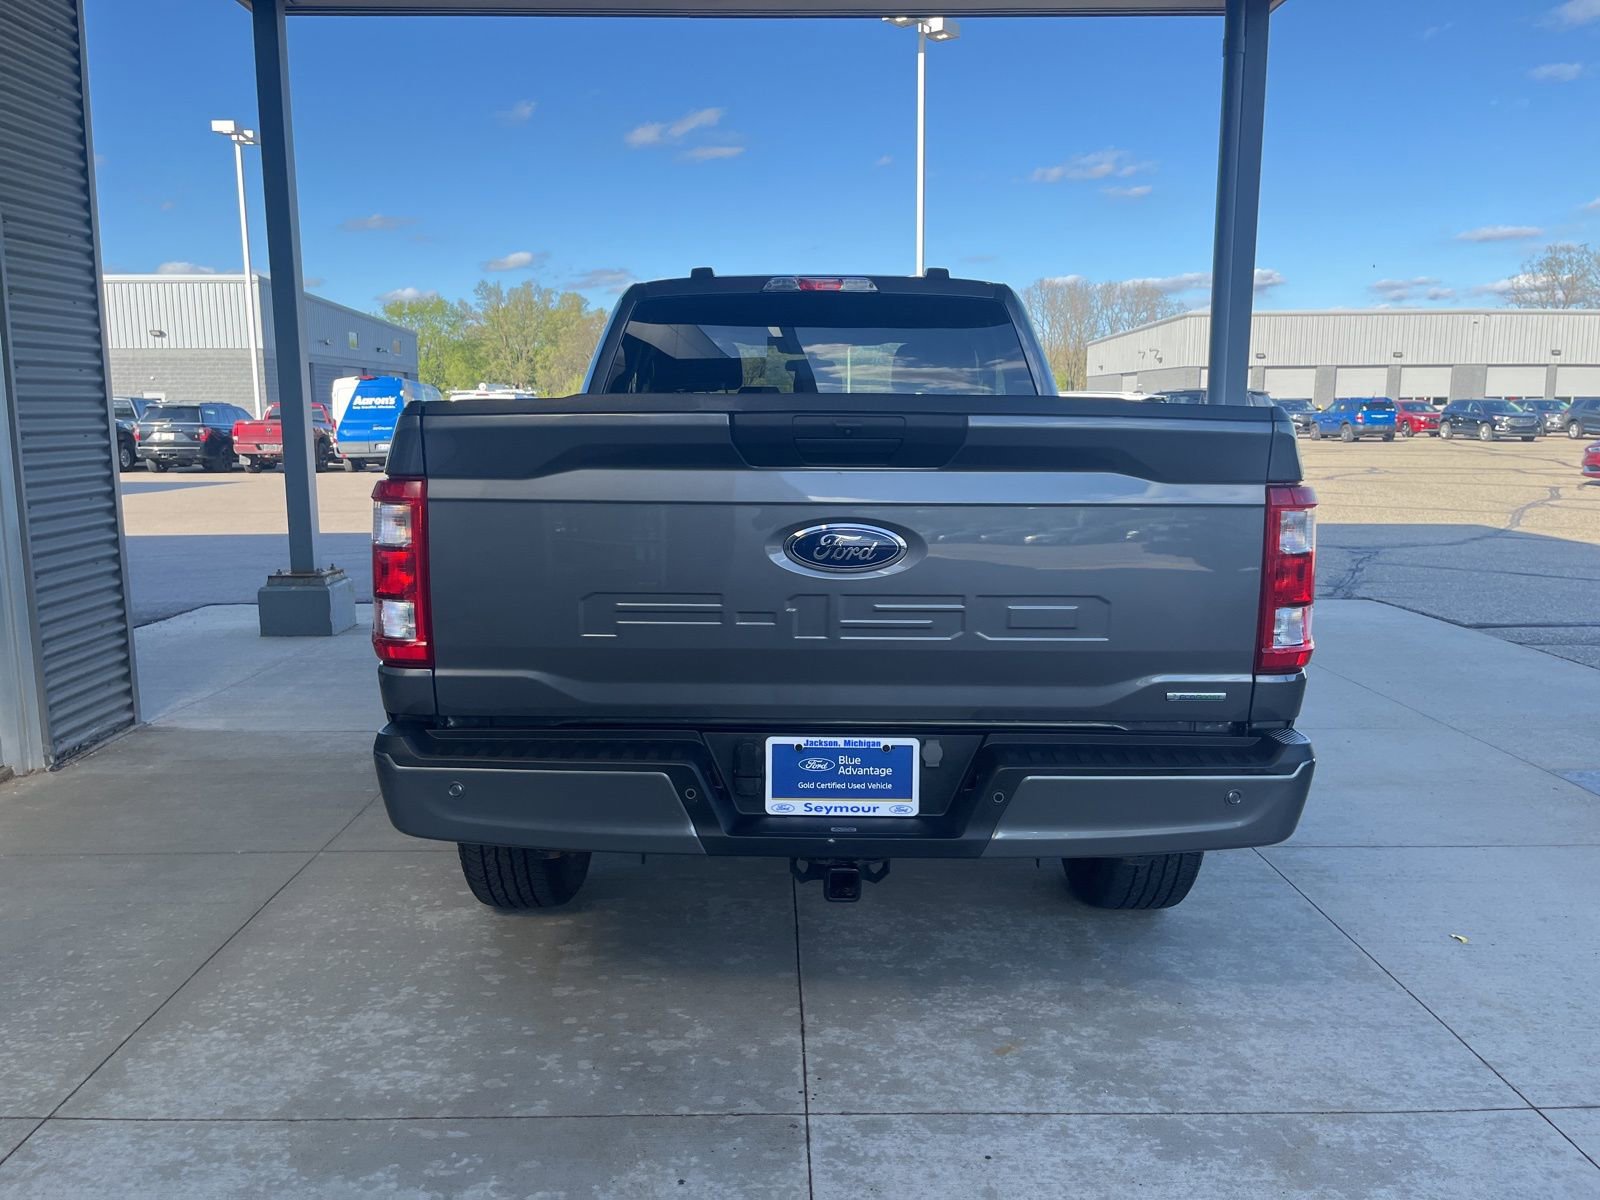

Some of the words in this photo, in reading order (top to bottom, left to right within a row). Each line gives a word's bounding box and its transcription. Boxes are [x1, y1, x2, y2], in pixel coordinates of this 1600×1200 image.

[813, 534, 878, 560] Ford
[579, 592, 1112, 642] F-150
[803, 739, 841, 748] Jackson,
[843, 739, 881, 748] Michigan
[805, 759, 828, 770] Ford
[838, 755, 861, 765] Blue
[838, 766, 893, 777] Advantage
[798, 781, 815, 789] Gold
[816, 781, 846, 789] Certified
[847, 782, 866, 790] Used
[867, 782, 893, 790] Vehicle
[803, 803, 880, 815] Seymour
